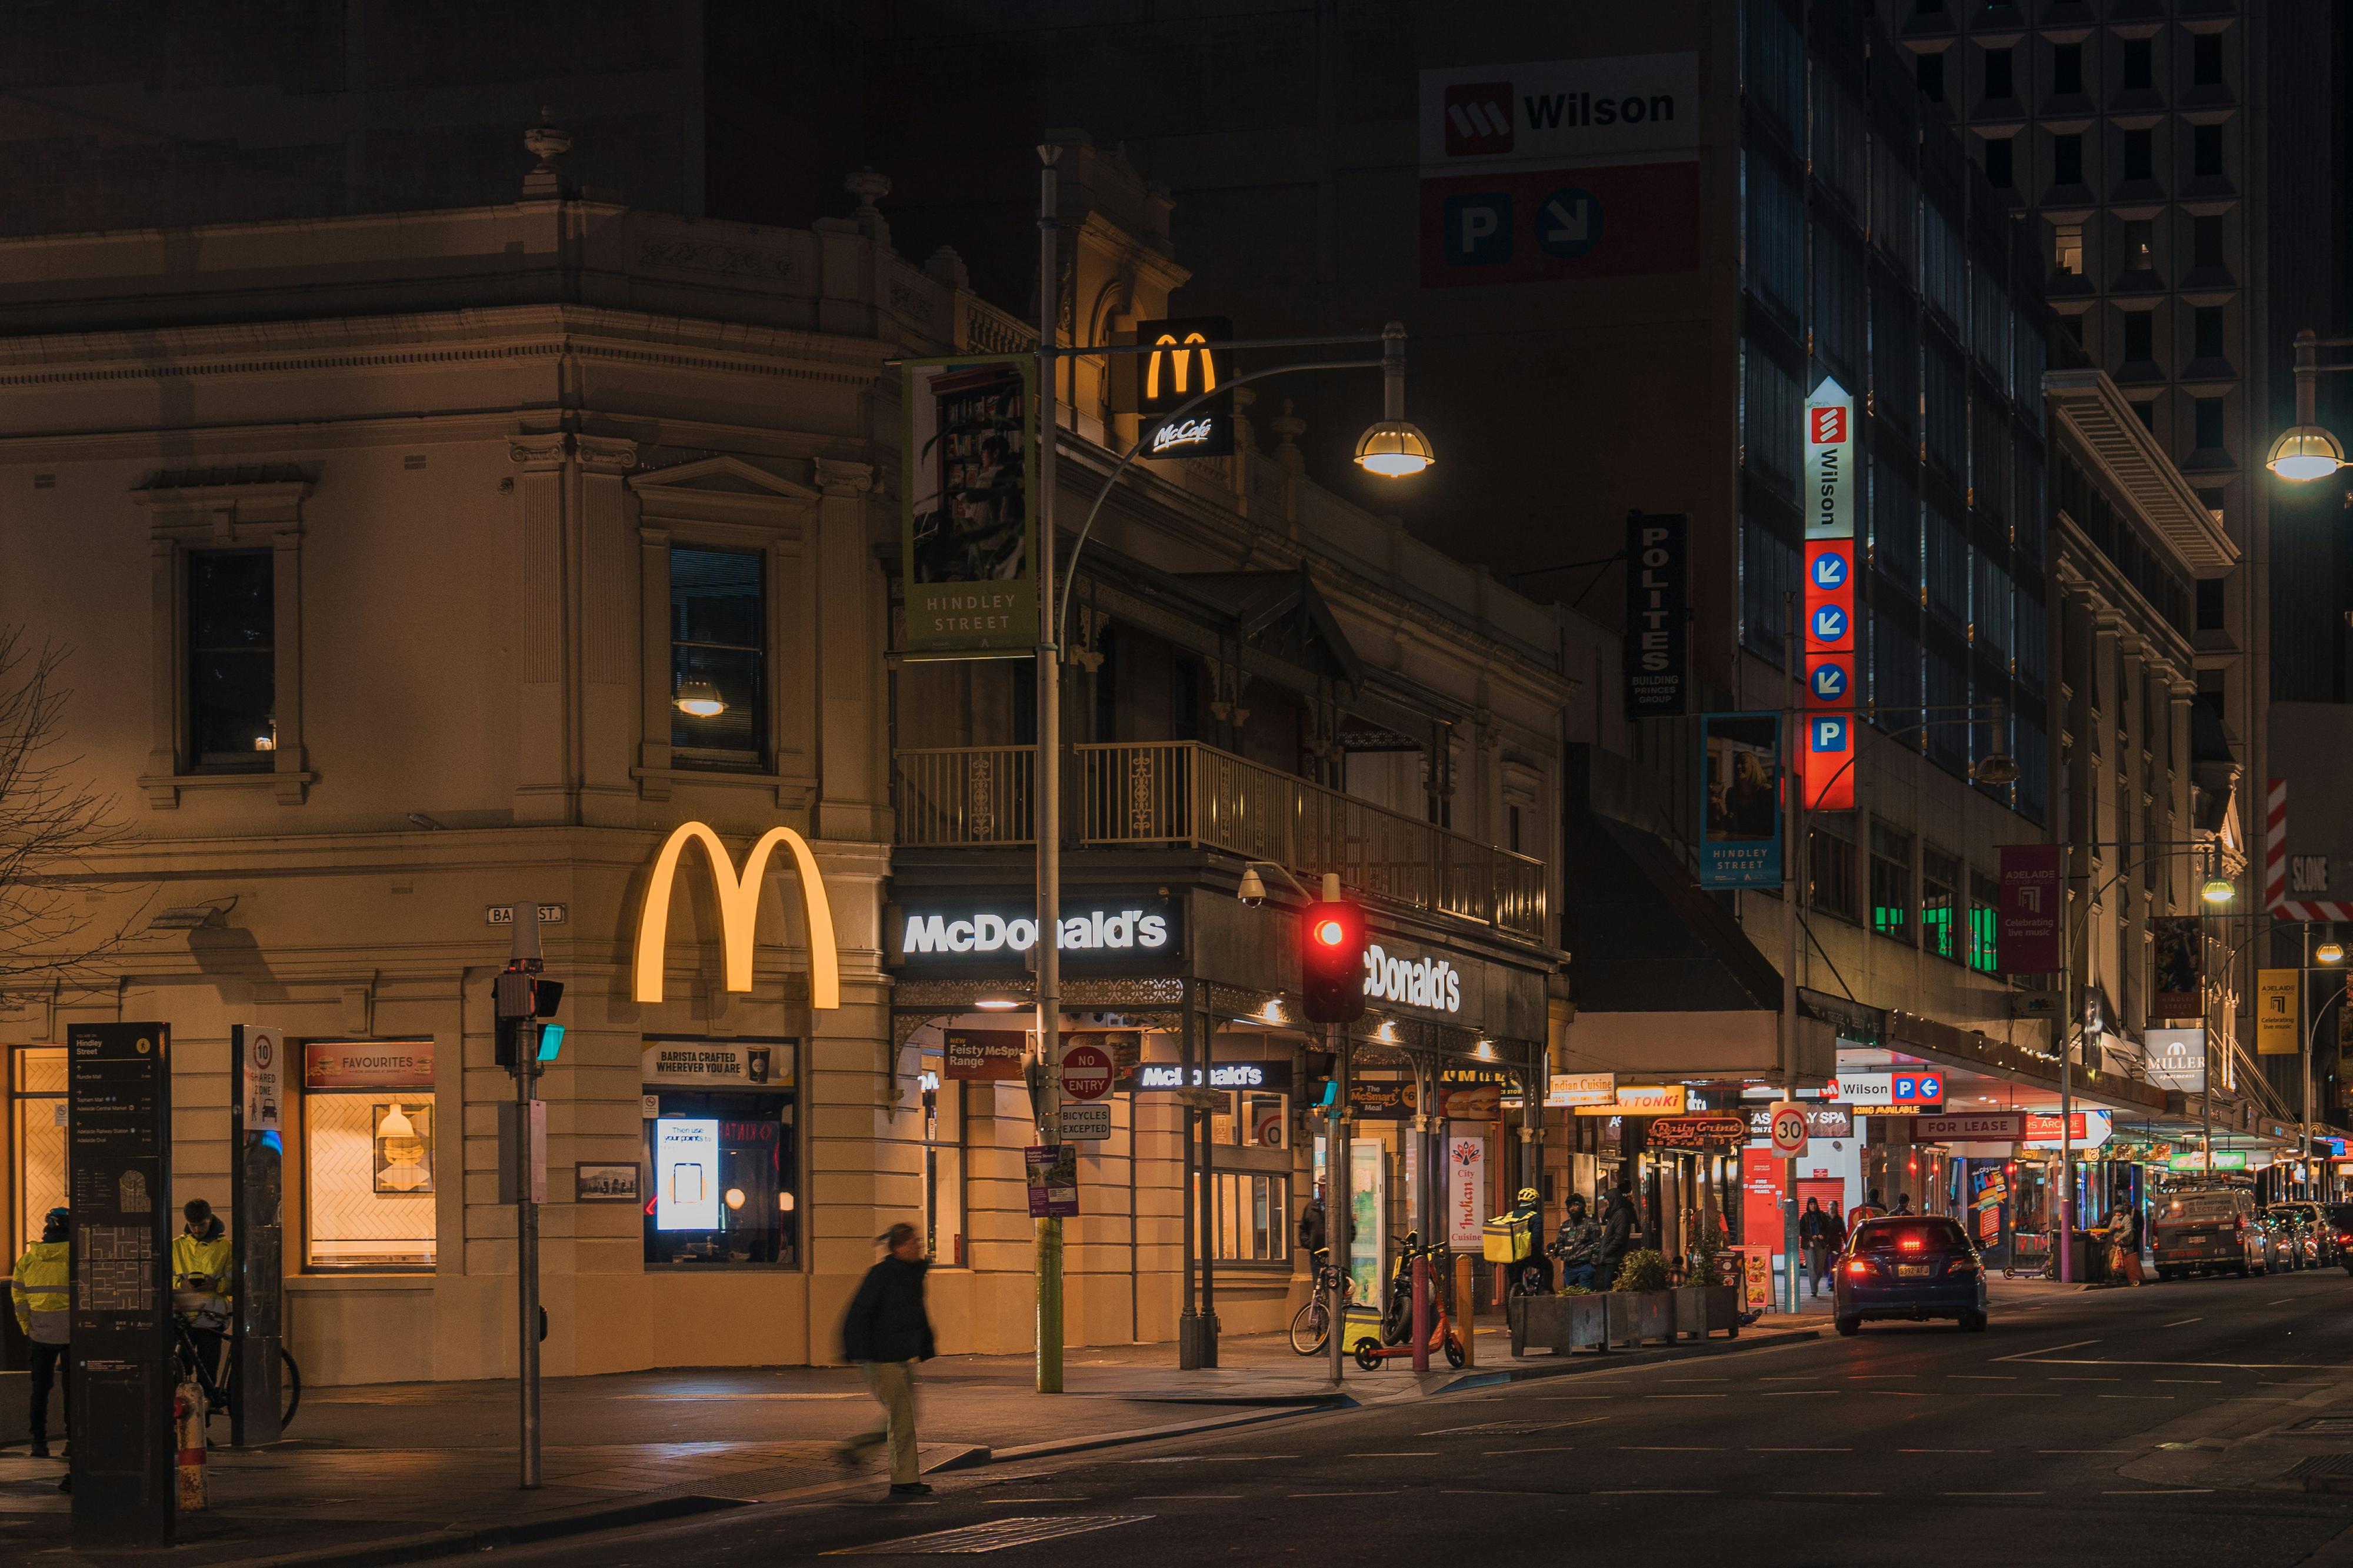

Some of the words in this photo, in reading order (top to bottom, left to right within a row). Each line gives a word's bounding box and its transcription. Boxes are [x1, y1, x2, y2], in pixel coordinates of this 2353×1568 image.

[1524, 92, 1675, 129] Wilson
[1821, 448, 1838, 525] Wilson
[926, 595, 1015, 610] HINDLEY
[1642, 527, 1669, 671] POLITES
[935, 616, 1009, 631] STREET
[1632, 675, 1679, 686] BUILDING
[1634, 685, 1676, 696] PRINCES
[1638, 695, 1672, 704] GROUP
[1713, 849, 1768, 858] HINDLEY
[1717, 860, 1764, 870] STREET
[2005, 870, 2055, 879] ADELAIDE
[2004, 918, 2054, 928] Celebrating
[2008, 928, 2024, 936] live
[2025, 928, 2051, 936] music
[76, 1039, 102, 1047] Hindley
[258, 1045, 268, 1060] 10
[949, 1044, 984, 1057] Feisty
[343, 1057, 413, 1067] FAVOURITES
[661, 1051, 697, 1062] BARISTA
[699, 1052, 736, 1063] CRAFTED
[949, 1056, 984, 1069] Range
[1078, 1056, 1095, 1066] NO
[656, 1062, 704, 1073] WHEREVER
[705, 1063, 723, 1073] YOU
[724, 1063, 741, 1074] ARE
[255, 1085, 272, 1096] ZONE
[1069, 1080, 1105, 1091] ENTRY
[1550, 1080, 1578, 1092] Indian
[1581, 1079, 1612, 1090] Cuisine
[1843, 1083, 1888, 1095] Wilson
[1351, 1092, 1397, 1102] McSmart
[1875, 1105, 1920, 1115] AVAILABLE
[1062, 1112, 1107, 1120] BICYCLES
[1819, 1112, 1847, 1124] SPA
[1062, 1125, 1107, 1133] EXCEPTED
[1778, 1120, 1801, 1139] 30
[1928, 1122, 1957, 1132] FOR
[1965, 1120, 2008, 1132] LEASE
[681, 1135, 704, 1143] points
[1457, 1169, 1475, 1179] City
[1459, 1180, 1475, 1229] Indian
[1451, 1233, 1482, 1241] Cuisine
